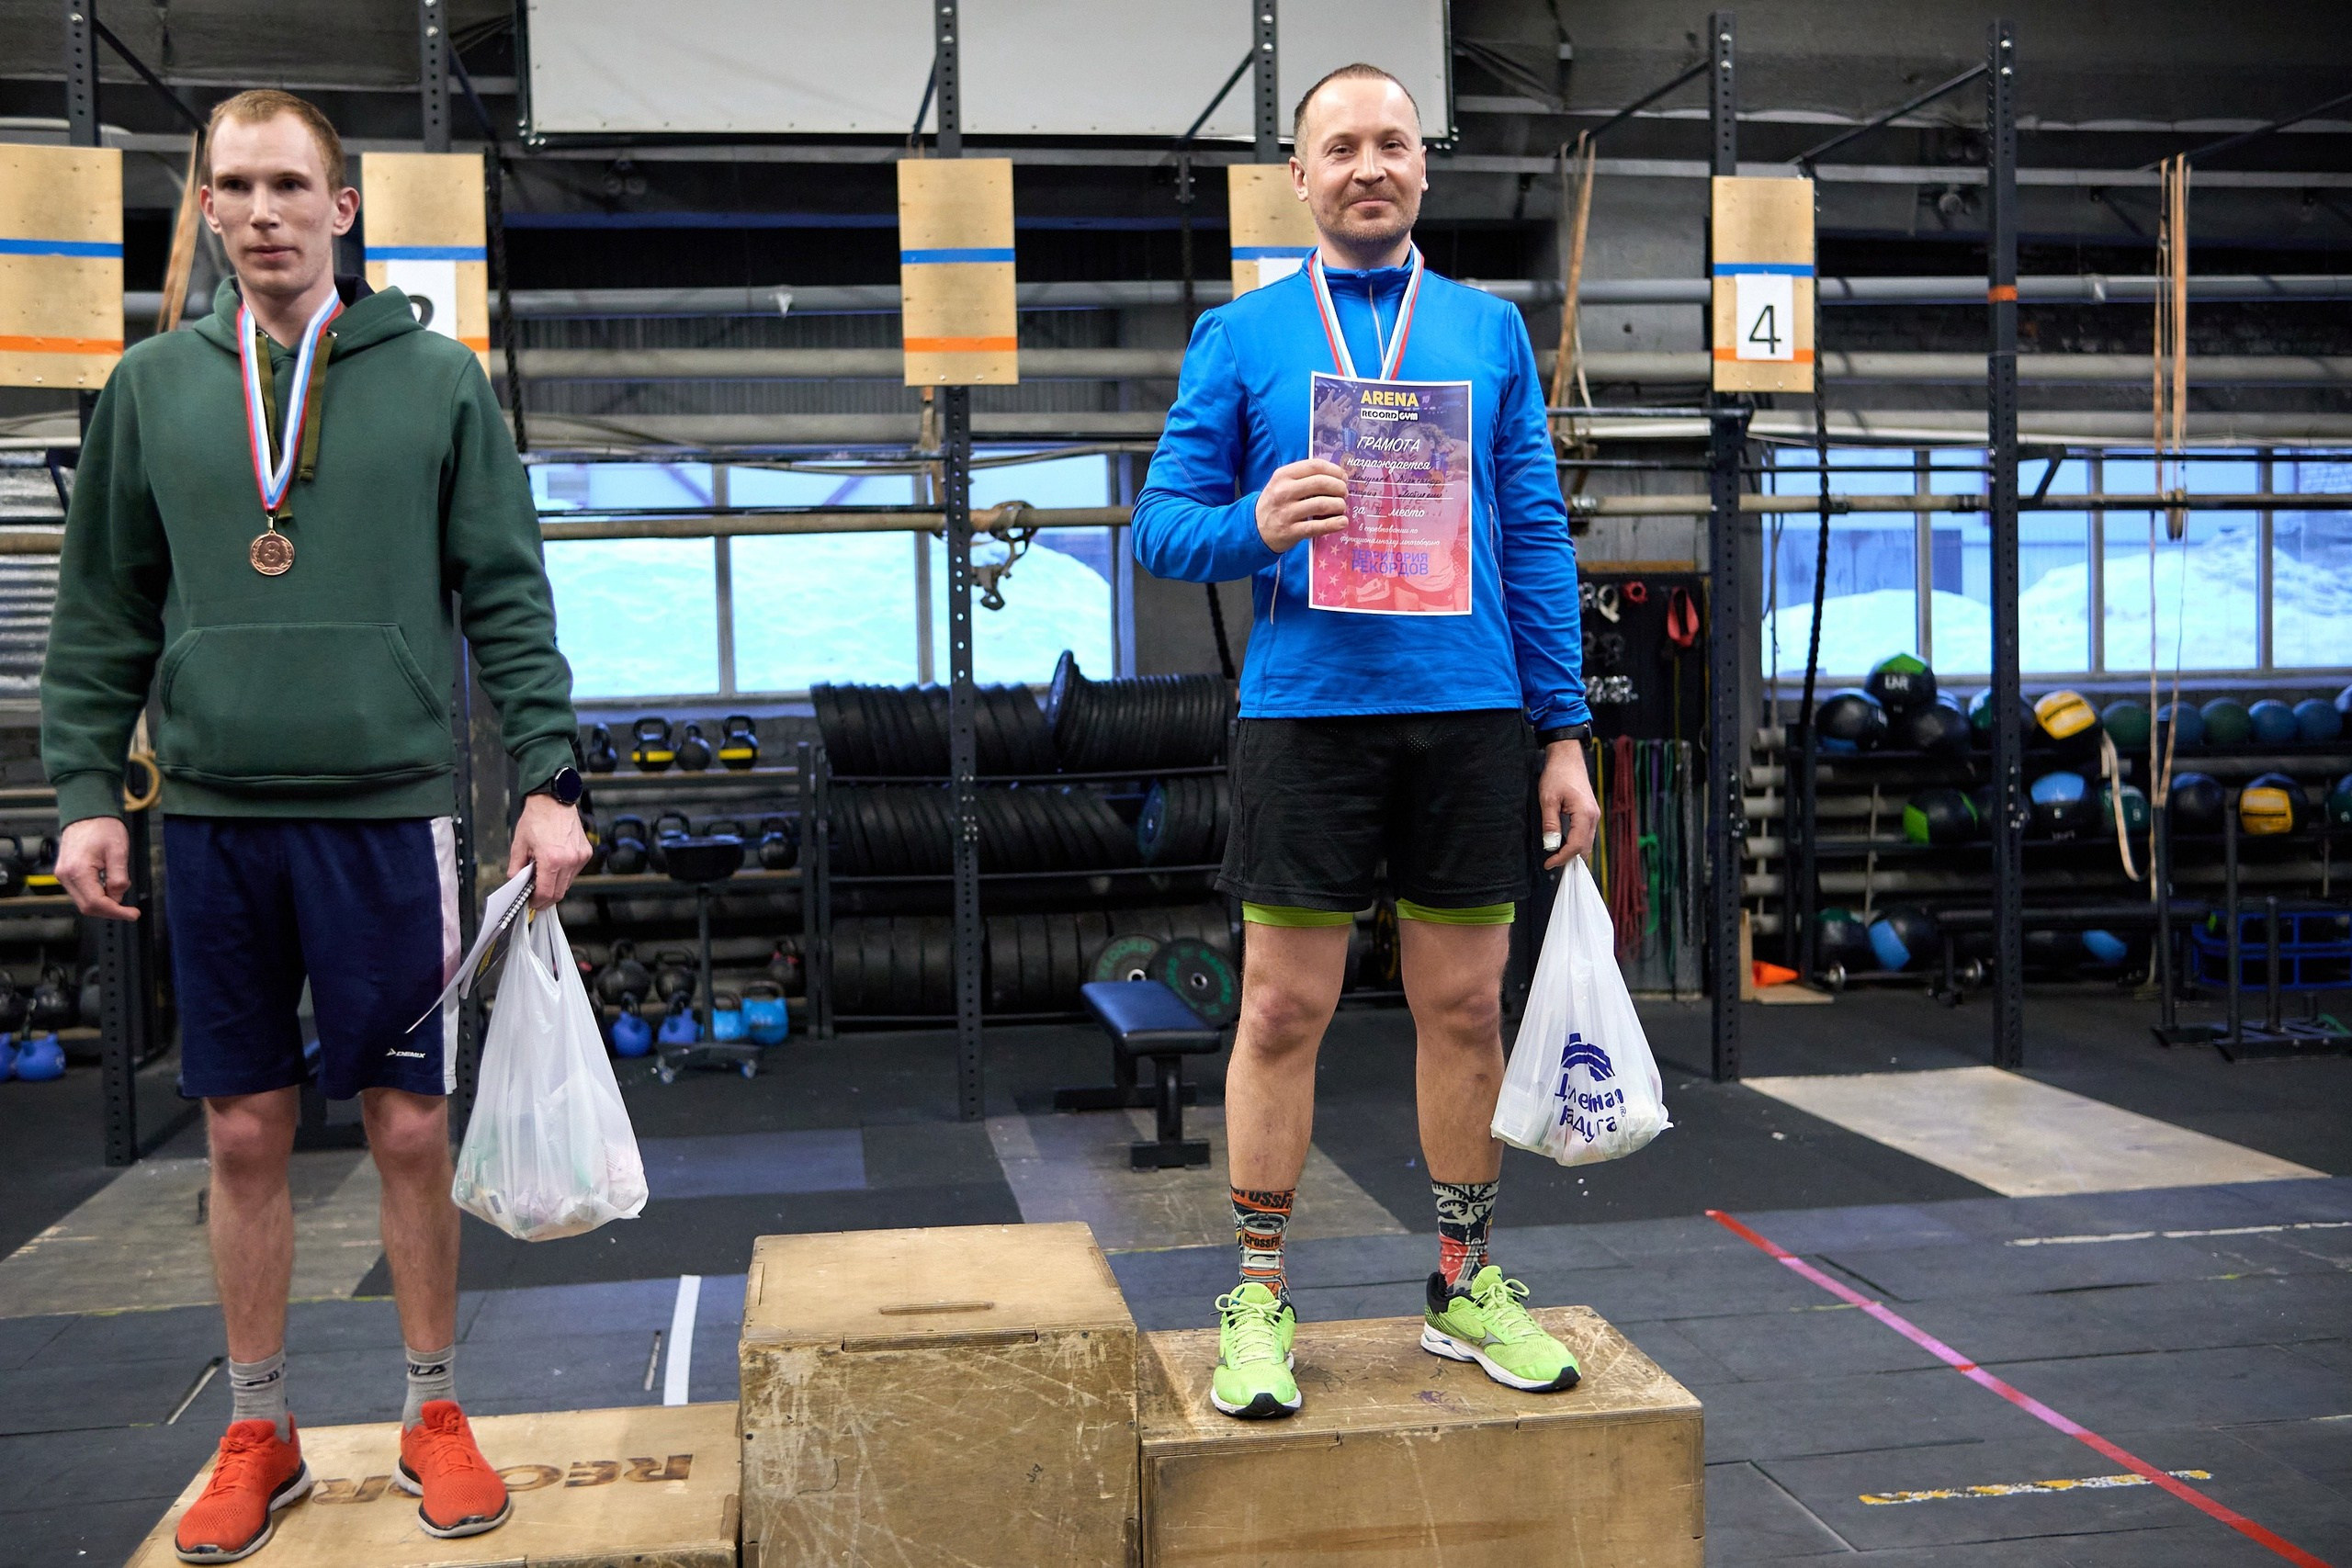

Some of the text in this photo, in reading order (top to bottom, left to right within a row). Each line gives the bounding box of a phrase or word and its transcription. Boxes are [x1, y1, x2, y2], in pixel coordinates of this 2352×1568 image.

[1748, 305, 1781, 355] 4
[1360, 389, 1419, 407] ARENA
[1362, 410, 1419, 422] RECORD GYM
[1356, 435, 1420, 453] ГРАМОТА
[1346, 457, 1431, 475] награждается
[1352, 506, 1426, 518] за место
[265, 540, 281, 562] 3
[1351, 549, 1429, 563] ТЕРРИТОРИЯ
[1351, 560, 1429, 577] РЕКОРДОВ
[1244, 1233, 1281, 1248] CrossFit
[407, 1363, 447, 1376] ILA
